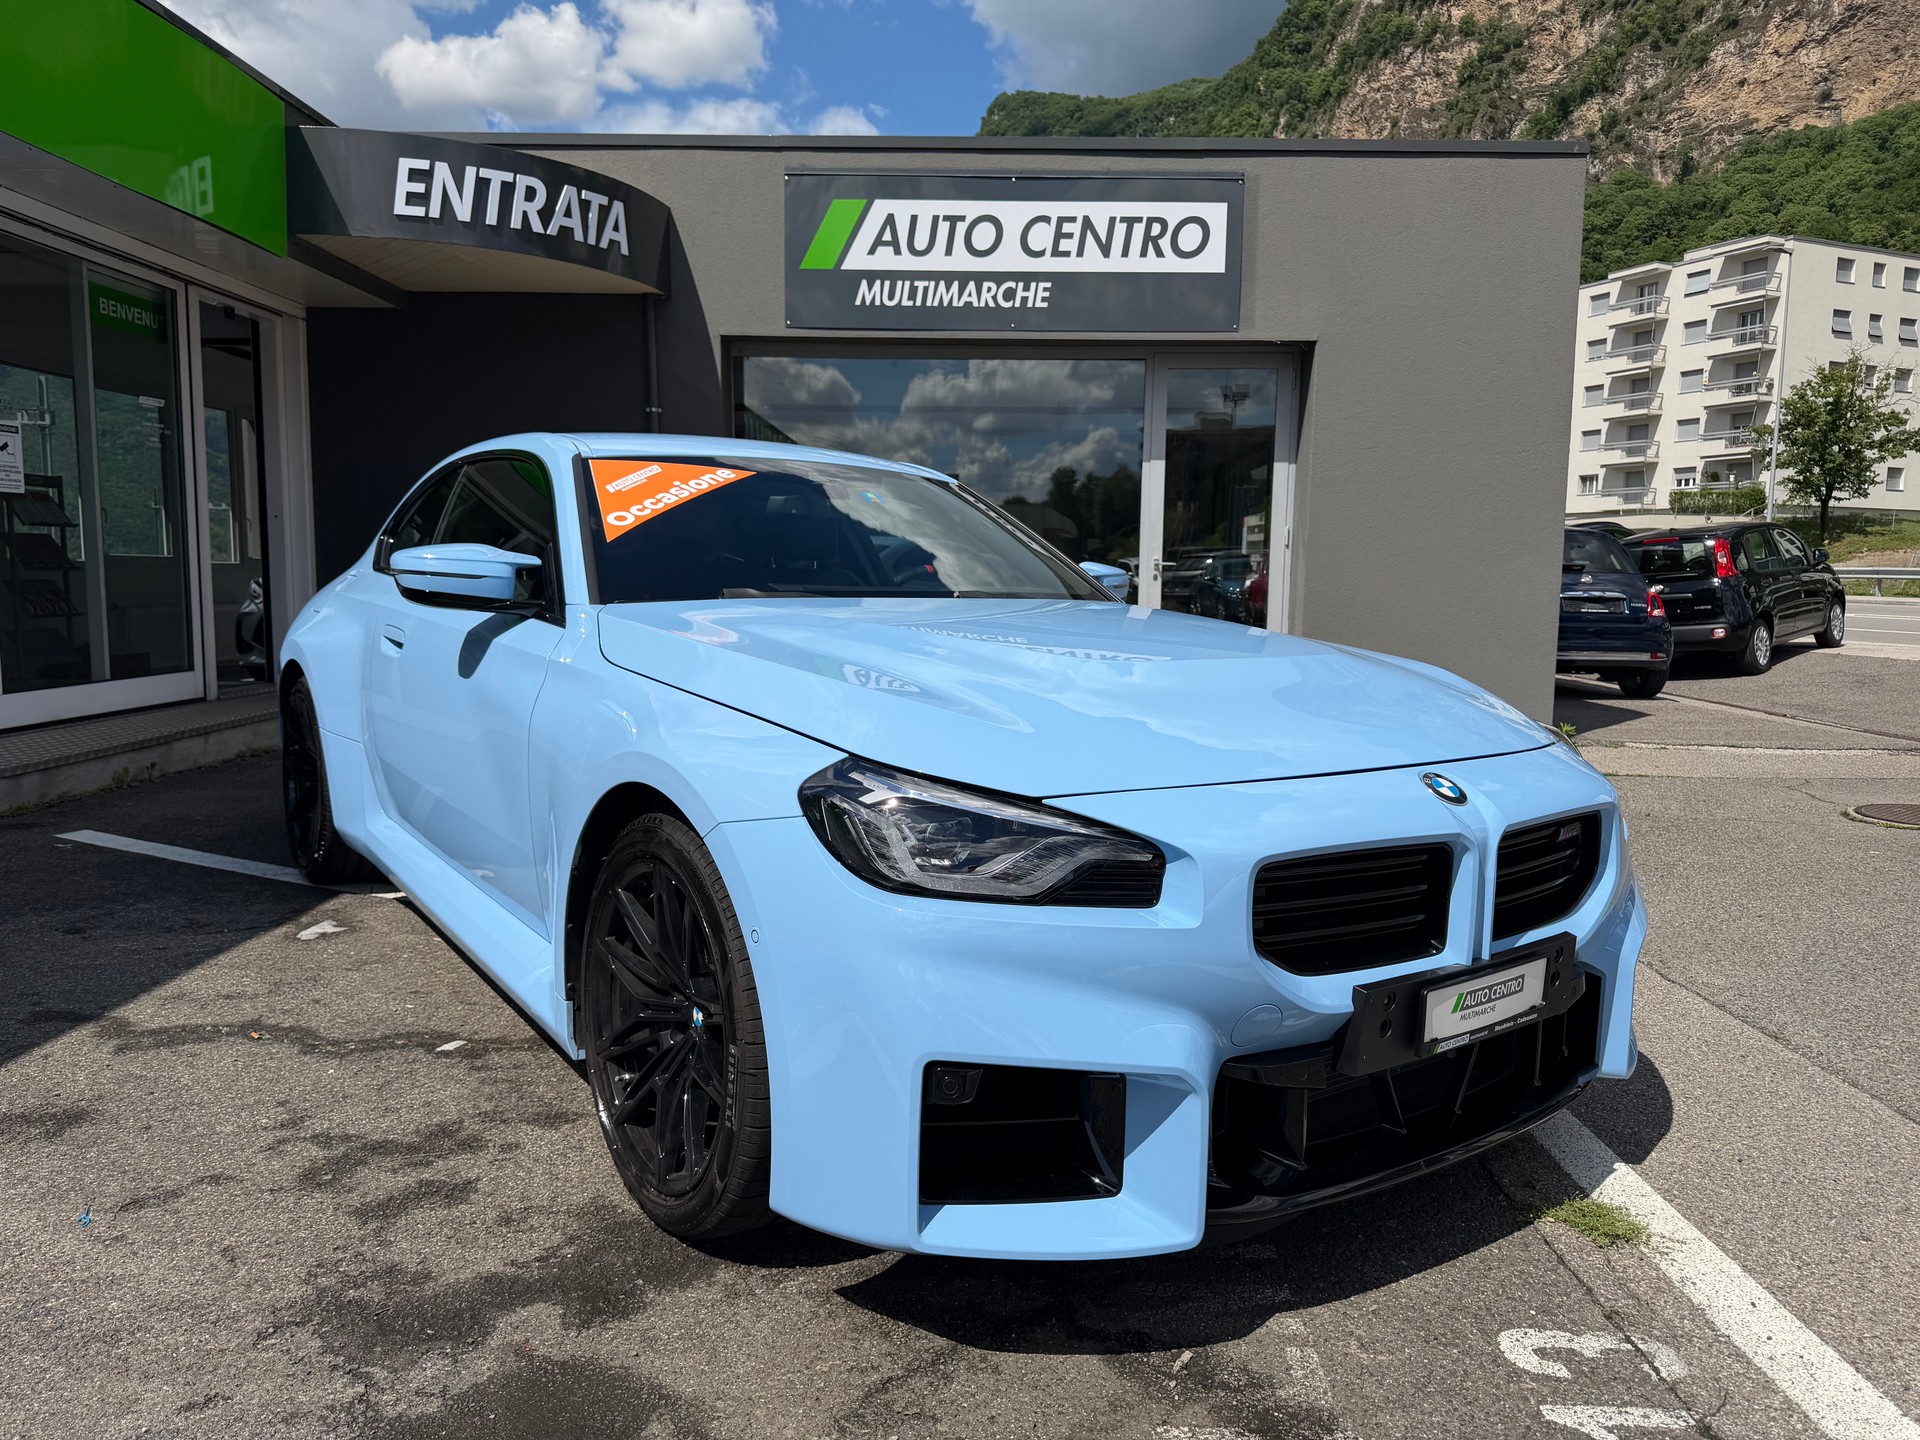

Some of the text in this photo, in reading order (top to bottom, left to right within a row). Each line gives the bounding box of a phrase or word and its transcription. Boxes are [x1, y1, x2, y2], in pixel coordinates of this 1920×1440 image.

[393, 157, 630, 256] ENTRATA
[867, 213, 1211, 260] AUTO CENTRO
[855, 279, 1052, 308] MULTIMARCHE
[606, 469, 736, 526] Occasione
[1463, 978, 1523, 1008] AUTO CENTRO
[1459, 1004, 1497, 1021] MULTIMARCHE
[1439, 1041, 1452, 1050] AUTO
